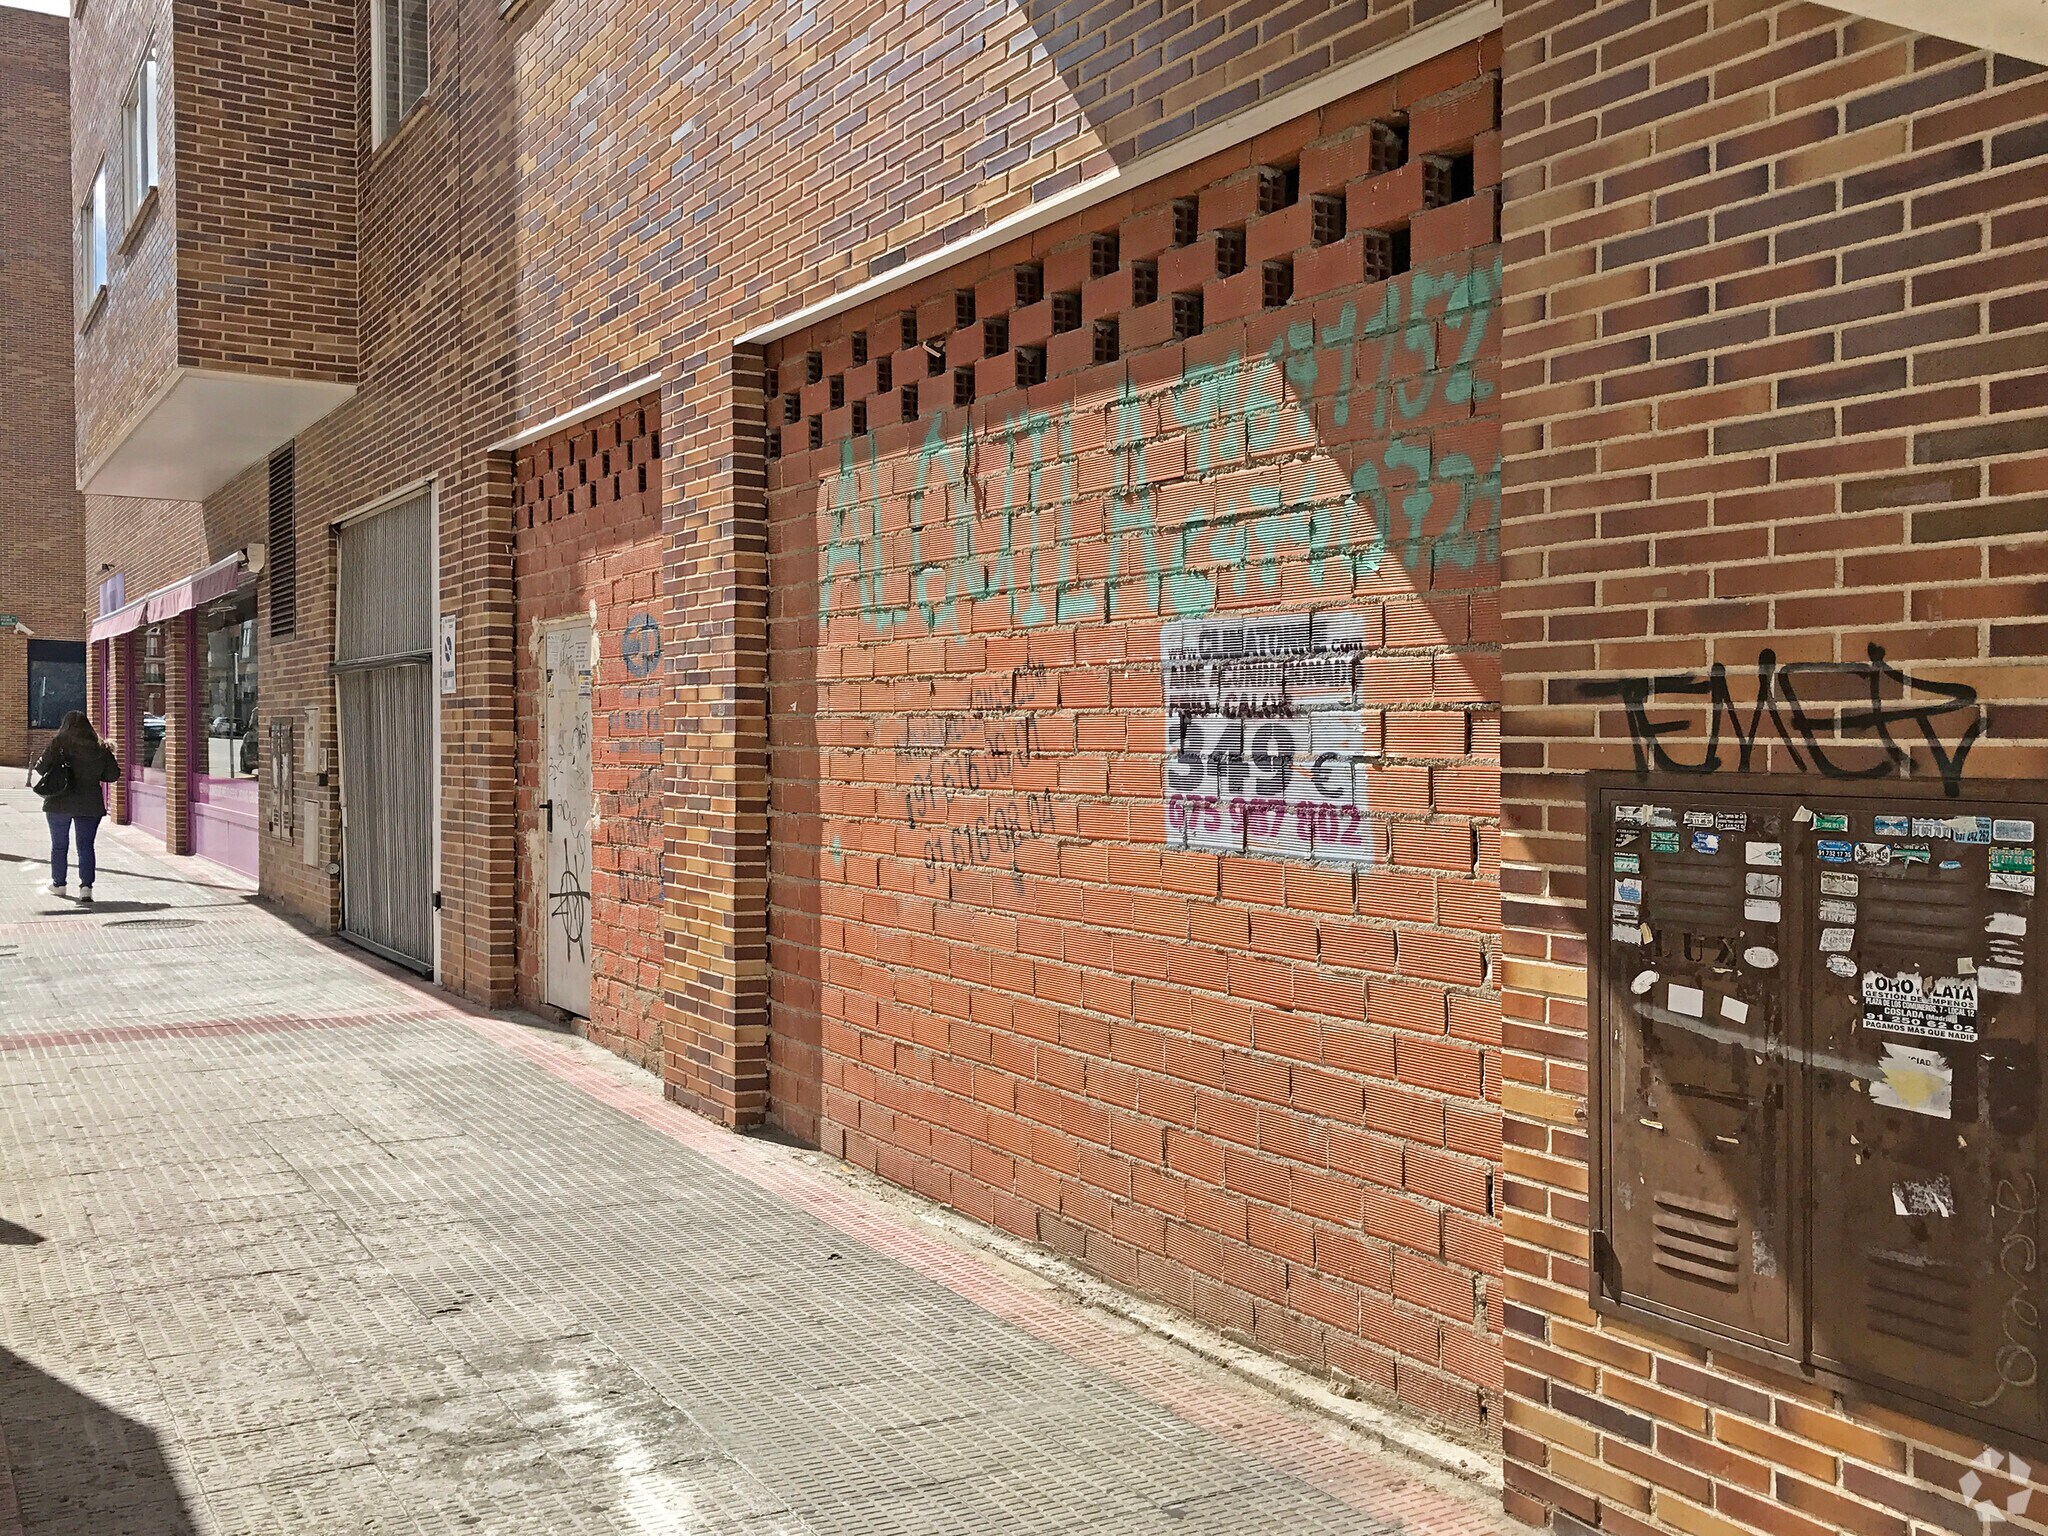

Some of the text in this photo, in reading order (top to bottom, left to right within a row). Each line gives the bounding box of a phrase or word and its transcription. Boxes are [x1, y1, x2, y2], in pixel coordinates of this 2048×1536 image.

[819, 378, 1161, 644] ALQUILA
[1169, 657, 1364, 689] AIRE ACONDICIONADO
[1222, 691, 1294, 718] CALOR
[1169, 721, 1344, 799] 349 €
[1168, 793, 1363, 846] 675 987 802
[923, 835, 946, 885] 91
[951, 816, 991, 873] 616
[1874, 976, 1914, 994] ORO
[1932, 985, 1975, 1001] LATA
[1865, 997, 1882, 1007] PLAZA
[1891, 999, 1901, 1008] LOS
[1948, 1007, 1966, 1016] LOCAL
[1967, 1009, 1975, 1017] 12
[1884, 1007, 1925, 1019] COSLADA
[1865, 1021, 1905, 1031] PAGAMOS
[1928, 1029, 1946, 1037] QUE
[1948, 1032, 1974, 1041] NADIE
[1866, 1012, 1974, 1033] 91 250 62 02
